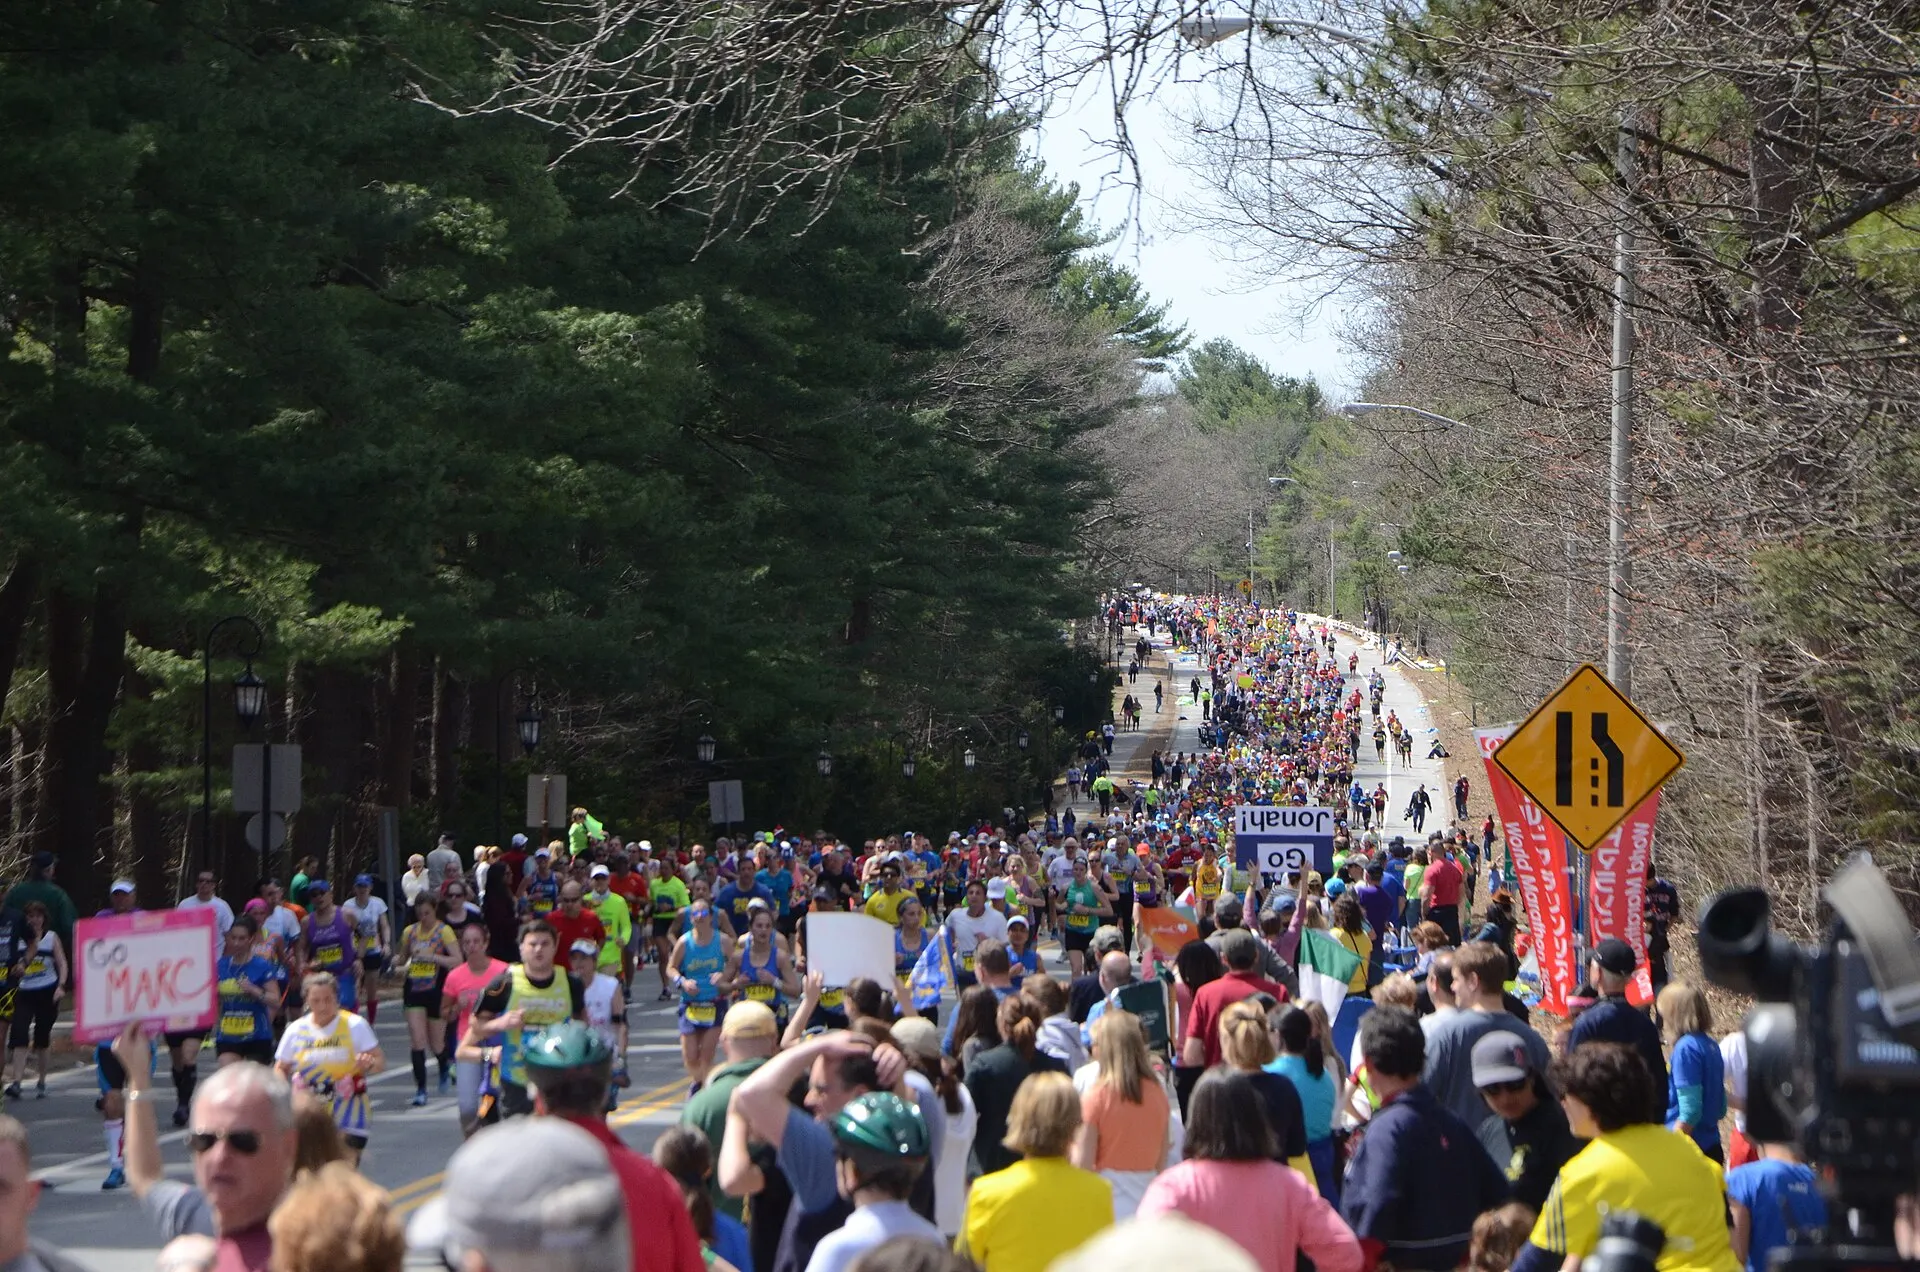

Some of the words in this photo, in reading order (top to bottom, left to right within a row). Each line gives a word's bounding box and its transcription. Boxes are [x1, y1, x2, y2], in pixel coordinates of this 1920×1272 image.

[1241, 811, 1330, 832] Jonah!
[1268, 848, 1306, 869] Go
[1504, 822, 1533, 872] World
[1520, 874, 1546, 962] Marathon
[105, 957, 211, 1014] MARC
